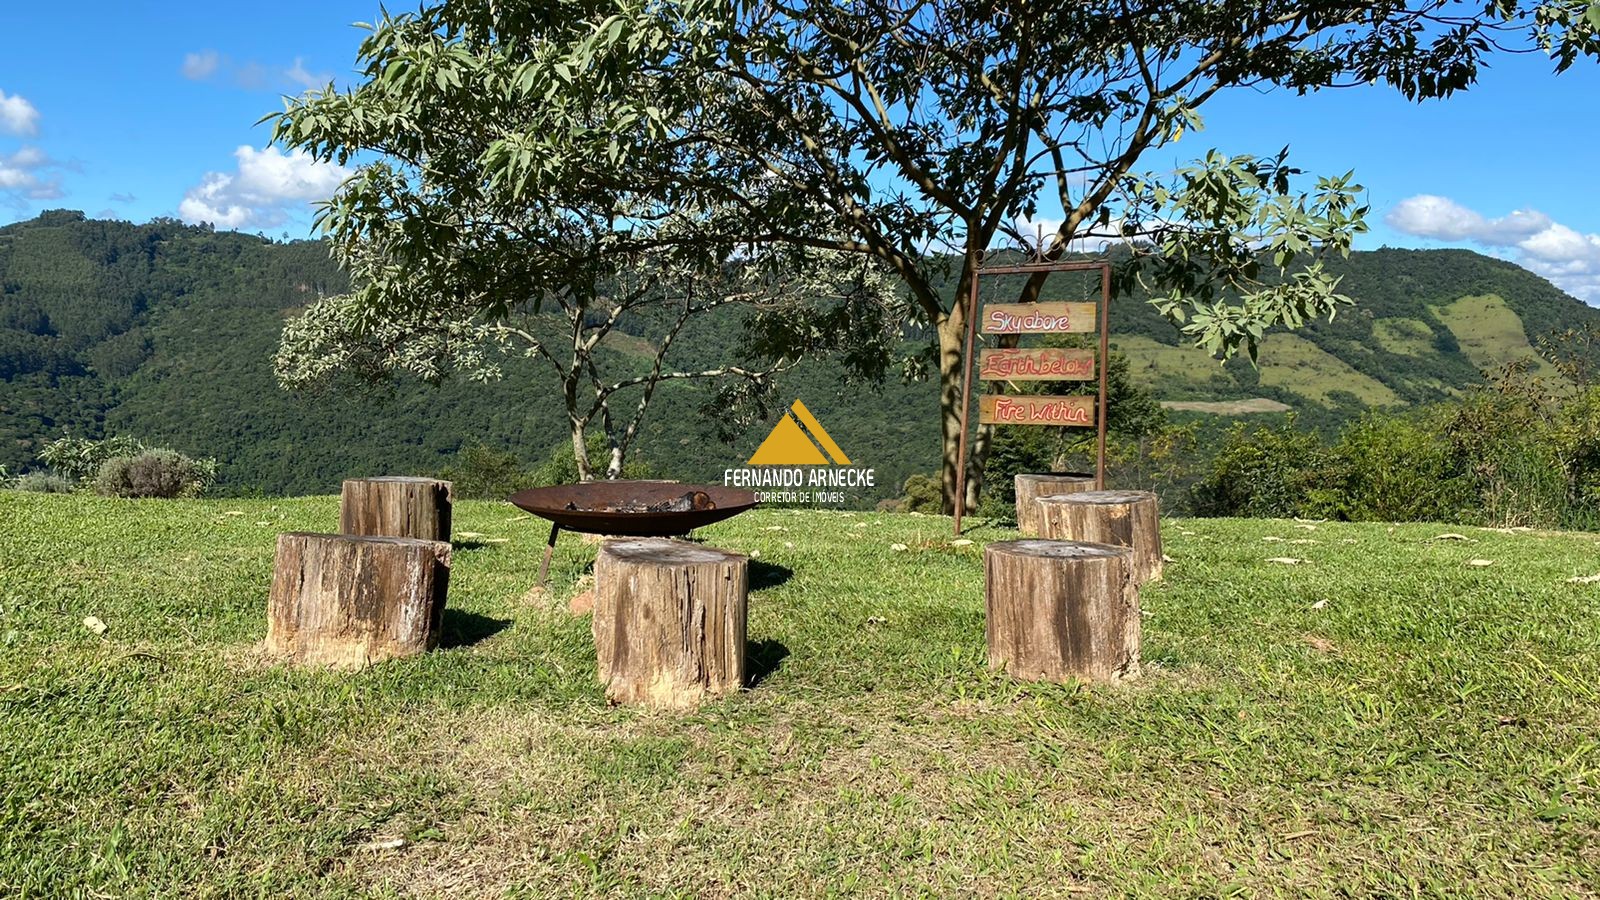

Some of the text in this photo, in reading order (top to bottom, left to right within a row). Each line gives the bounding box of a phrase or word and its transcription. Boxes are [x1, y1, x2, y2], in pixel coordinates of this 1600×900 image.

[987, 310, 1069, 332] Sky above
[982, 353, 1093, 376] Earth below
[994, 399, 1026, 420] Fire
